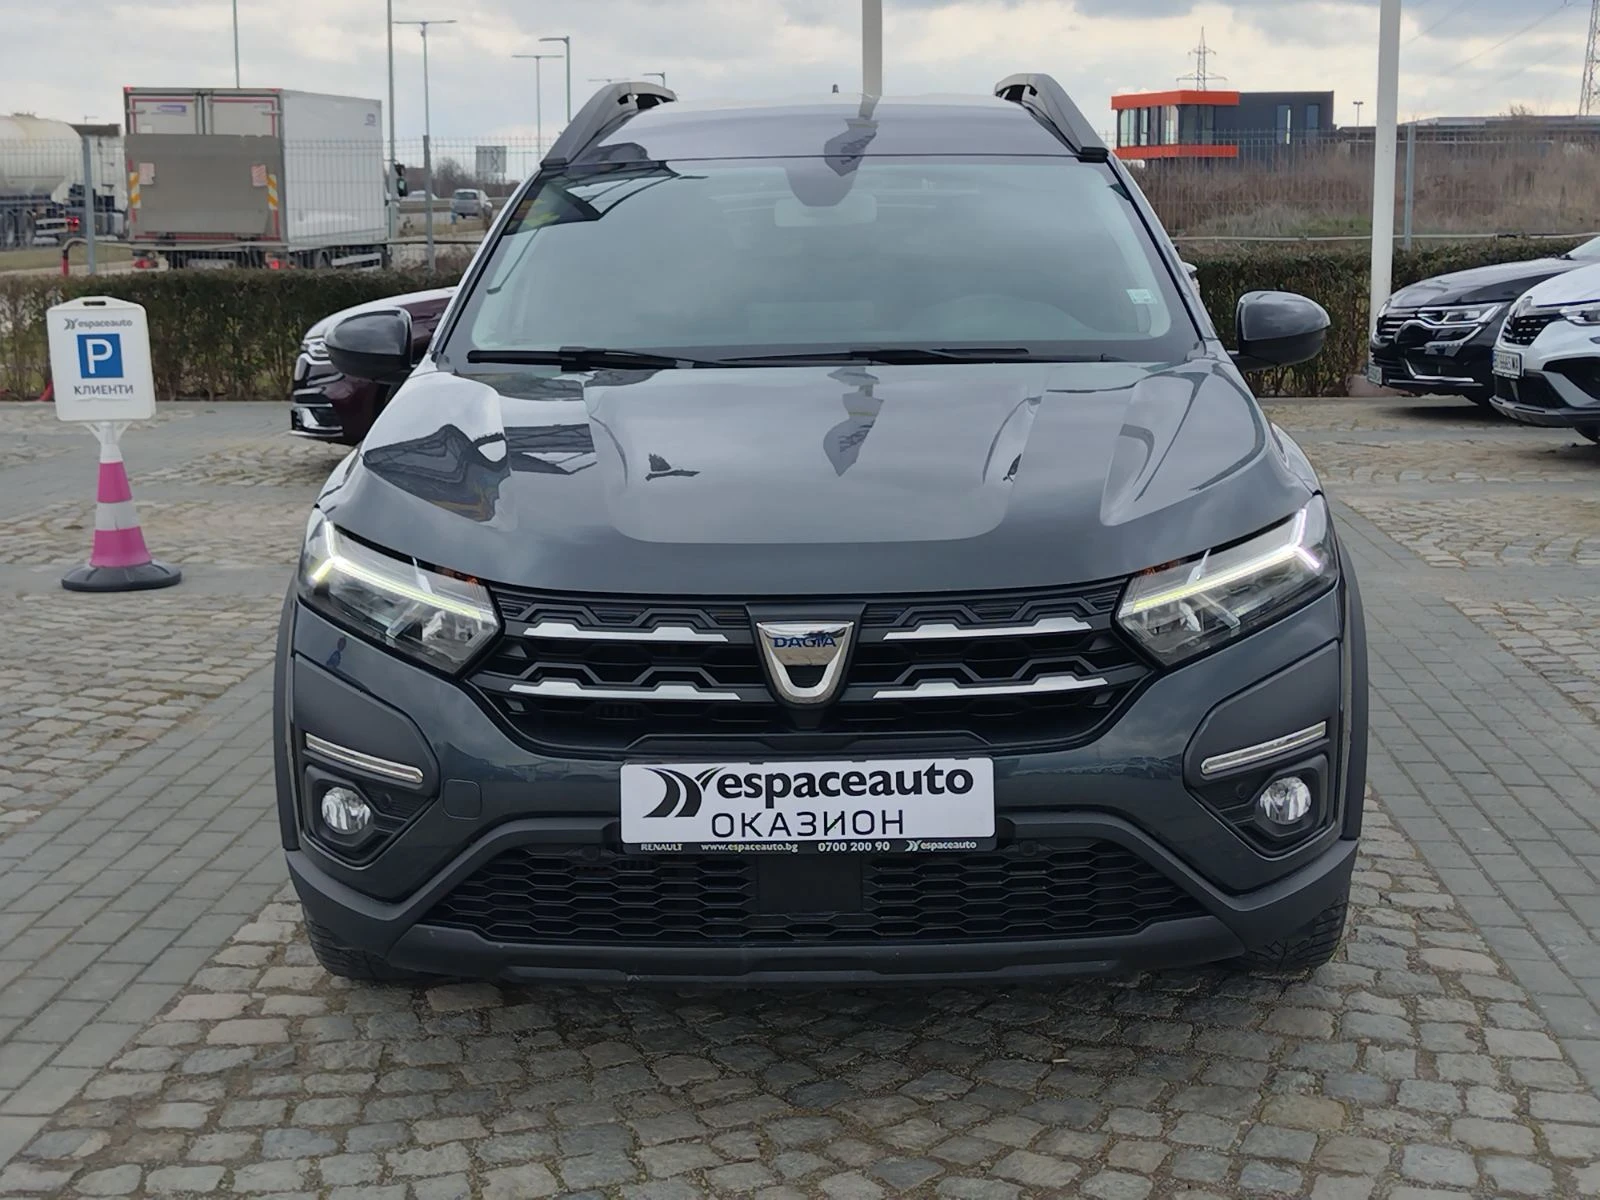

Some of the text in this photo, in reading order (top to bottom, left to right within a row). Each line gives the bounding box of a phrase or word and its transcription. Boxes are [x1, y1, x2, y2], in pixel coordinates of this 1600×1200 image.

[78, 319, 133, 329] espaceauto
[85, 338, 113, 374] P
[73, 384, 134, 395] КЛИЕНТИ
[716, 762, 974, 809] espaceauto
[711, 809, 903, 838] ОКАЗИОН
[640, 843, 683, 851] RENAULT
[700, 842, 799, 853] www.espaceauto.bg
[817, 841, 891, 852] 0700 200 90
[920, 840, 977, 851] espaceauto
